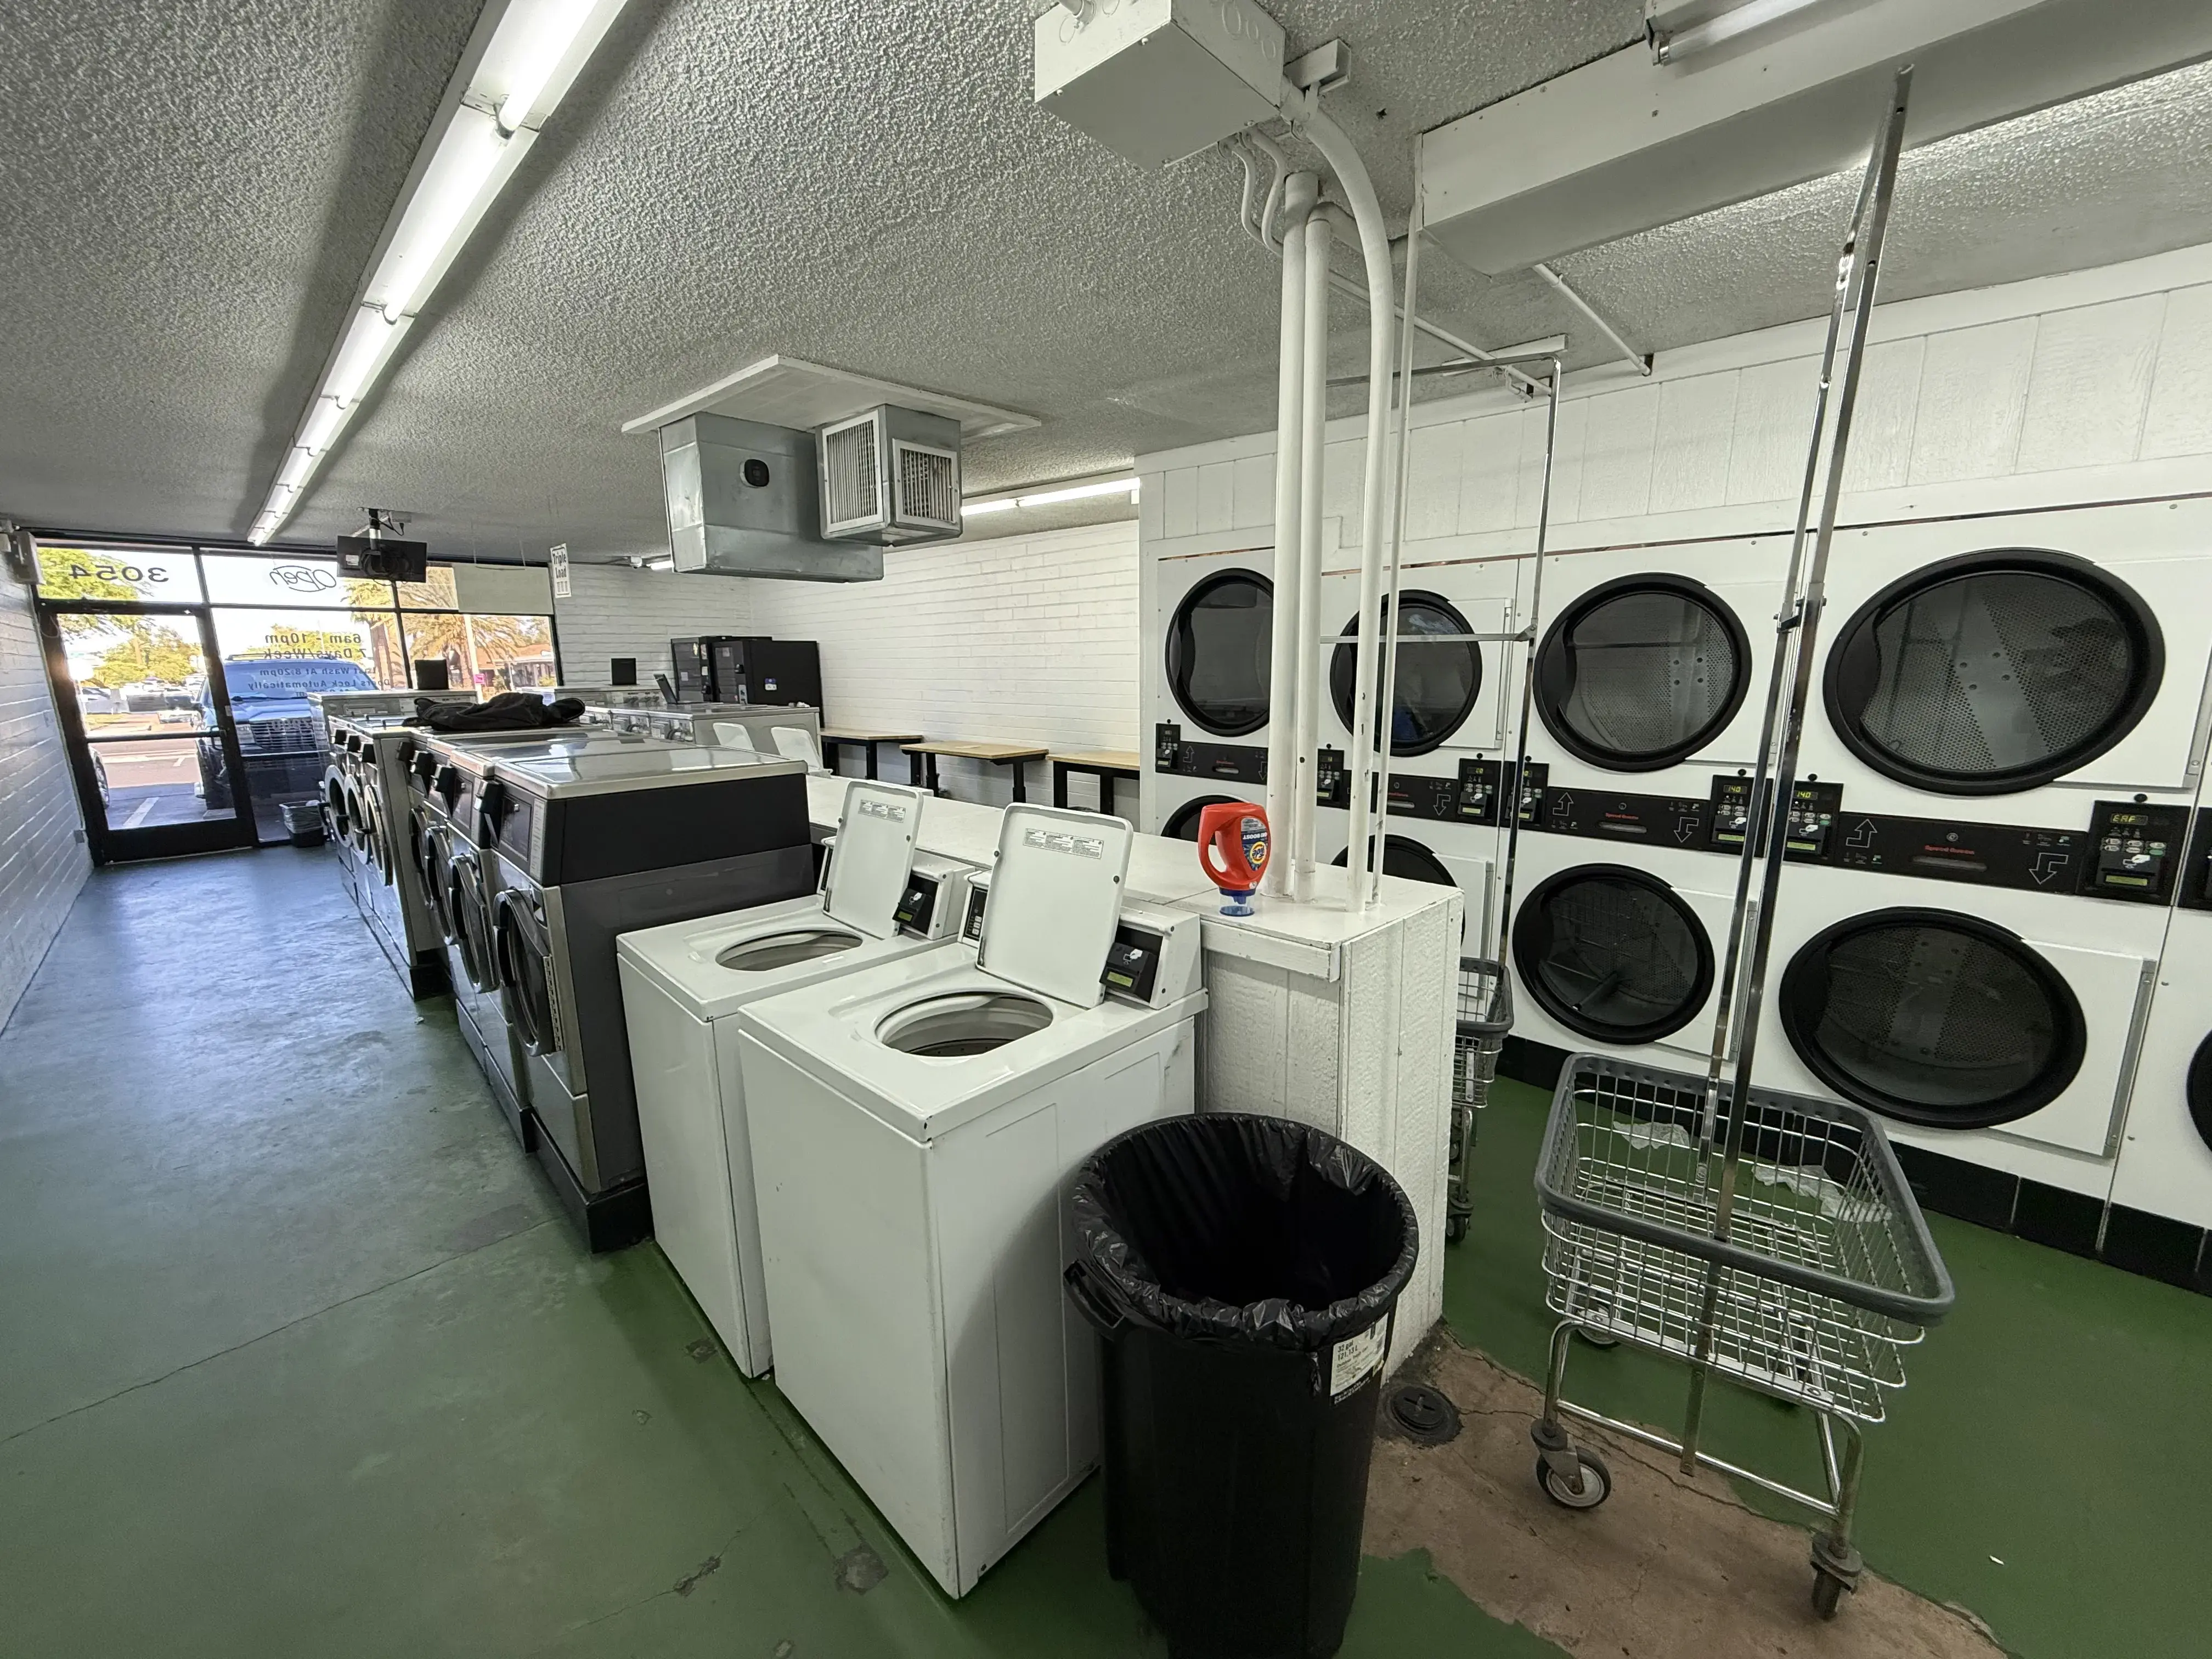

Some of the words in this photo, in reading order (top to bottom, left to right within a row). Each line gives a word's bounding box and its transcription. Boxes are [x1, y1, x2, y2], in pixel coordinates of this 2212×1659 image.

[552, 551, 567, 567] Triple
[555, 565, 567, 579] Load
[1252, 847, 1265, 859] Tide
